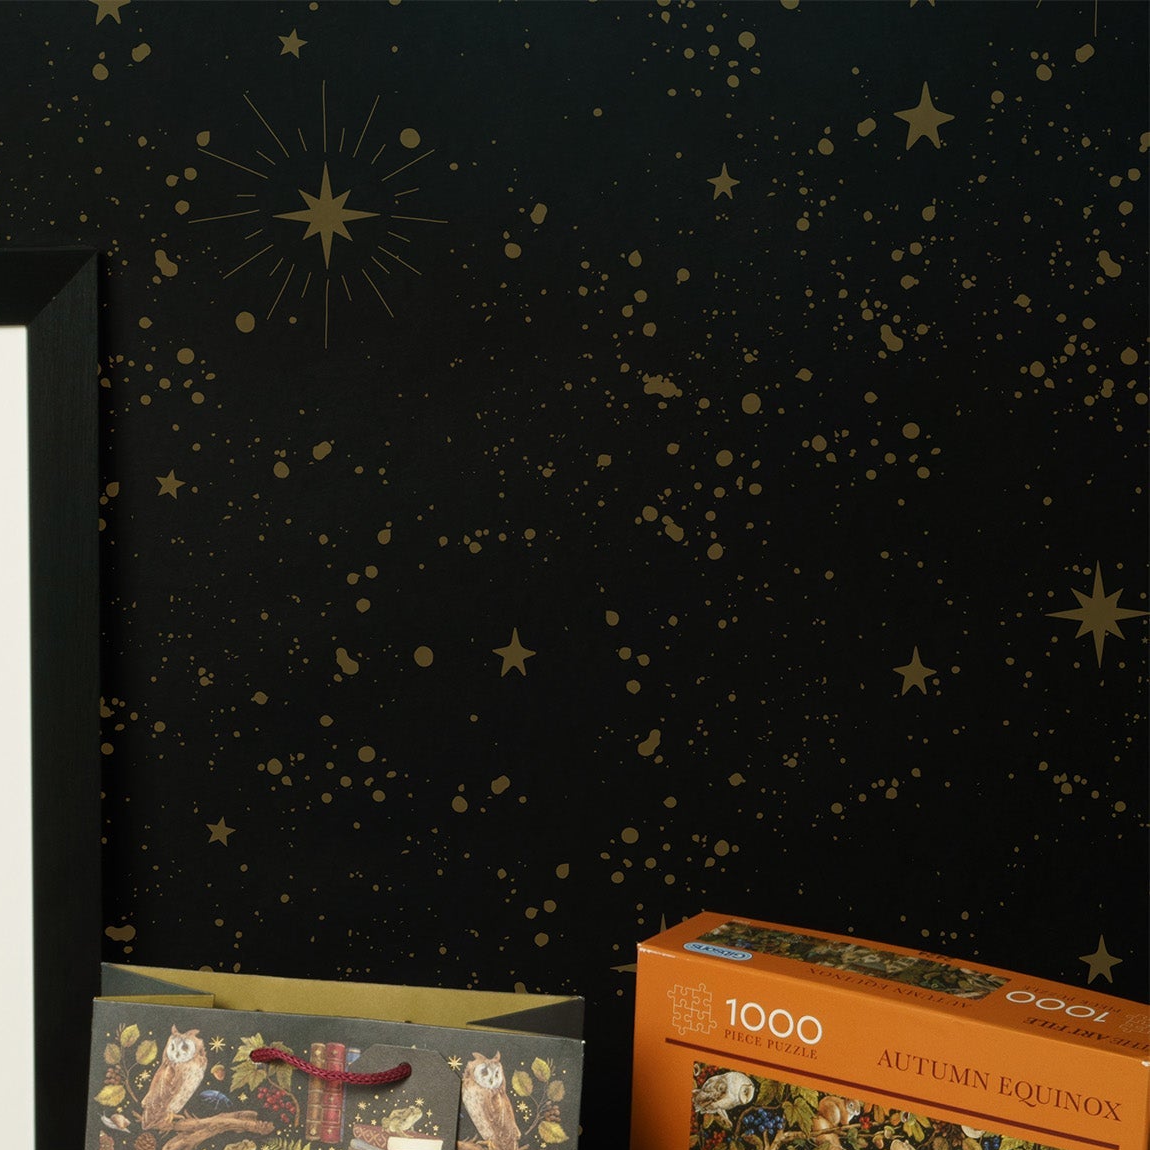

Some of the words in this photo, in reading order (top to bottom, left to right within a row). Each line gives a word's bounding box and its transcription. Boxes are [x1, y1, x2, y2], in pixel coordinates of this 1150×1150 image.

[725, 998, 823, 1045] 1000
[1005, 990, 1109, 1023] 1000
[724, 1029, 762, 1047] PIECE
[767, 1039, 818, 1060] PUZZLE
[877, 1048, 990, 1091] AUTUMN
[999, 1075, 1123, 1122] EQUINOX
